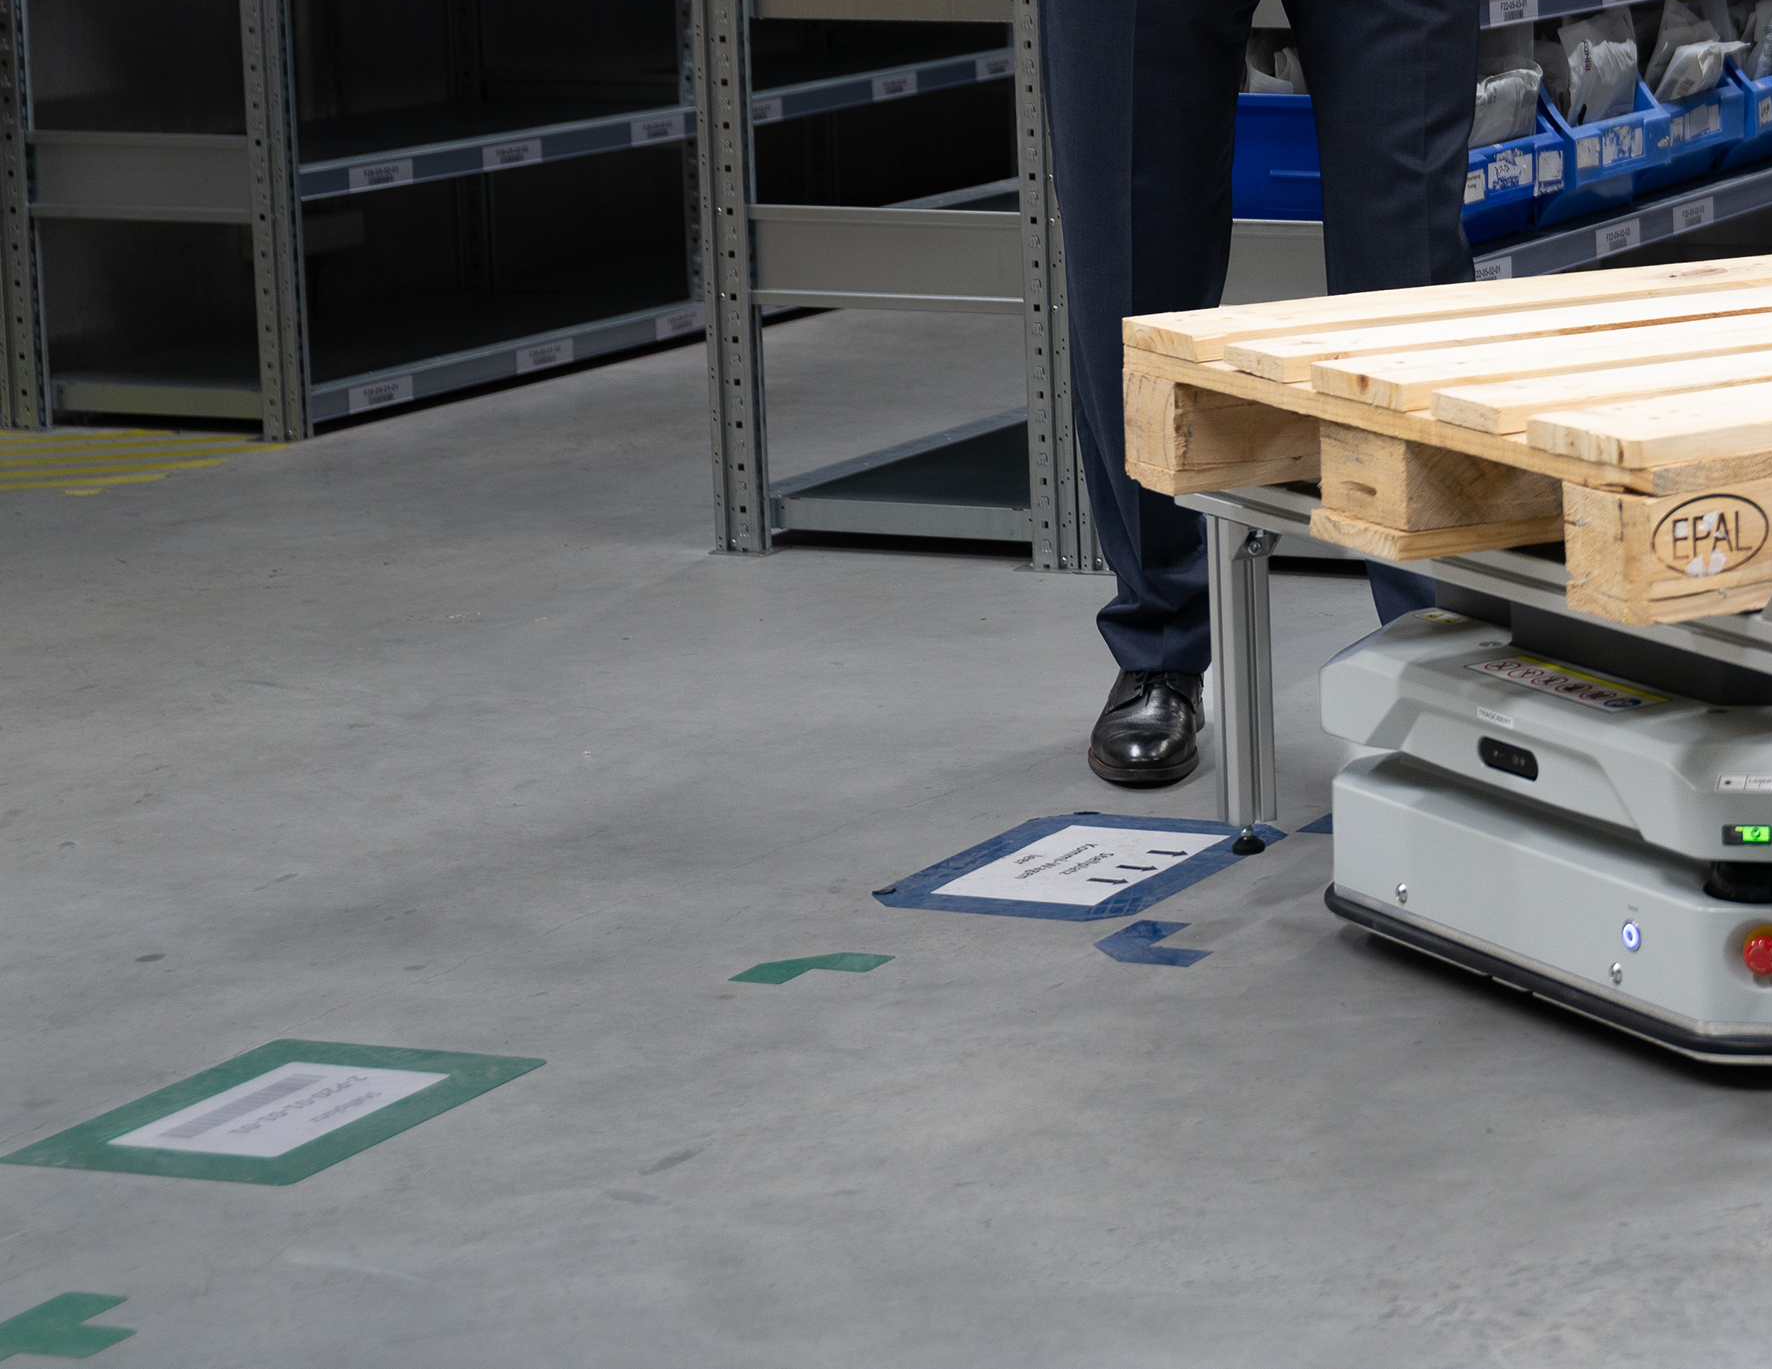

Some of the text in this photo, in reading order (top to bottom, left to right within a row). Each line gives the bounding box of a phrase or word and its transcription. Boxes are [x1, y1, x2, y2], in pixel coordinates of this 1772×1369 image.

[1500, 0, 1528, 12] F22-05-03-01
[1474, 265, 1501, 279] 22-05-02-01
[1672, 510, 1753, 560] EPAL
[1015, 842, 1098, 881] Kommi-Wagen
[1059, 851, 1115, 876] Stellplatz
